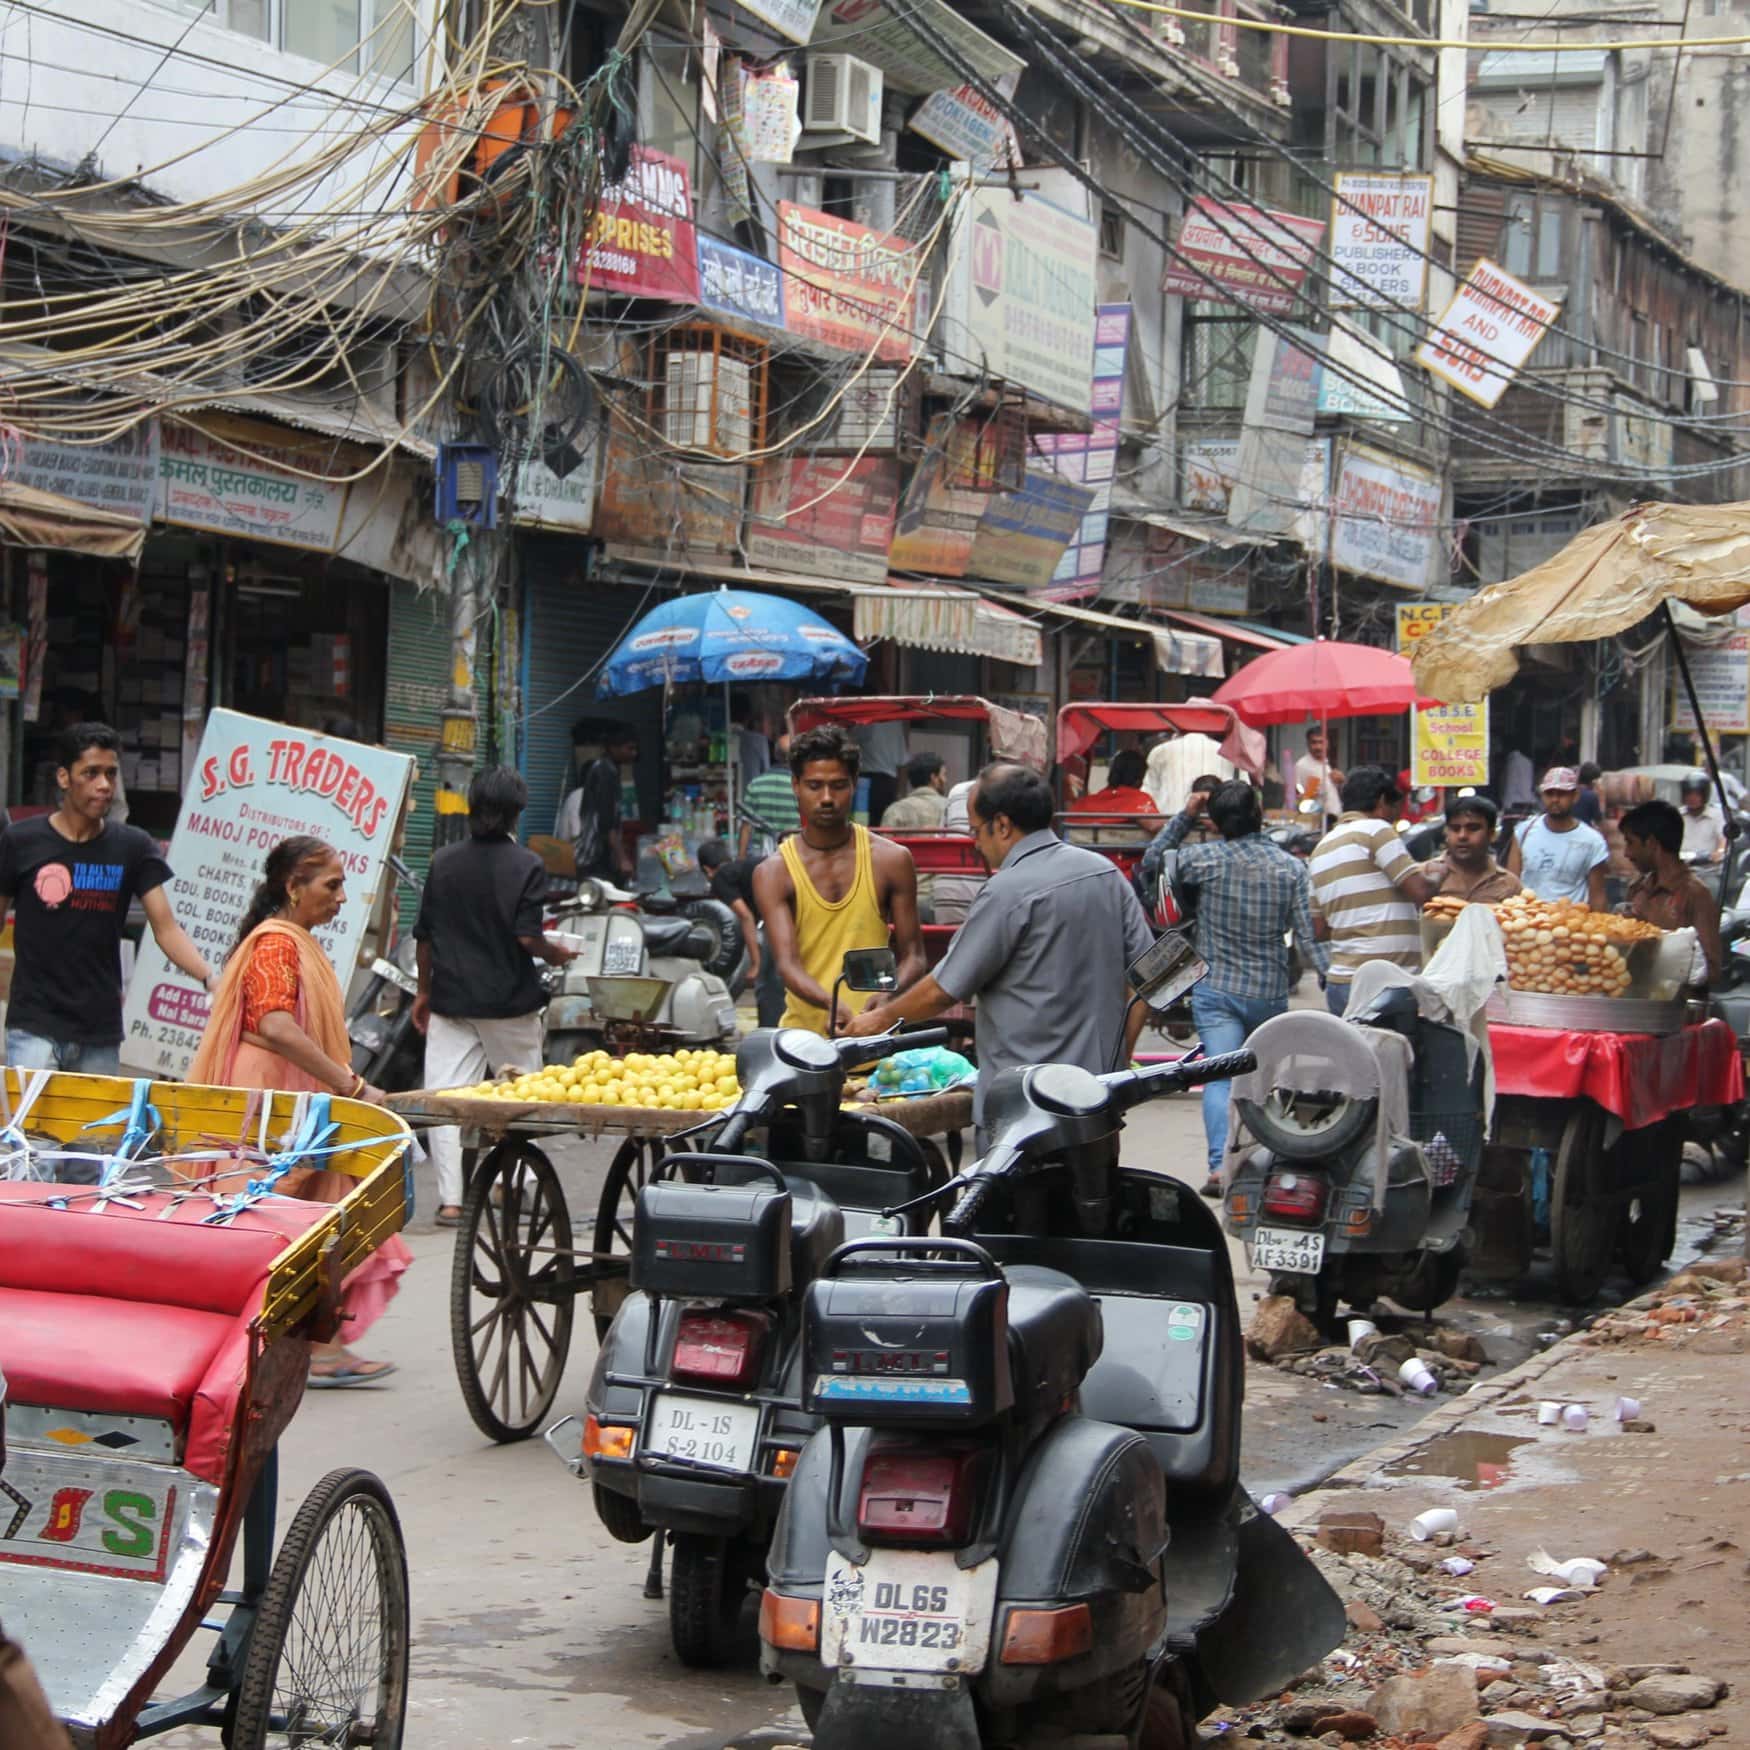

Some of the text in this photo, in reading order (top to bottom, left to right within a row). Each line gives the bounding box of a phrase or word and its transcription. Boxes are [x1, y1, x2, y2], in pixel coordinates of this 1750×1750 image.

[1403, 194, 1426, 219] RAI
[1363, 220, 1411, 244] SONS
[1334, 246, 1422, 262] PUBLISHERS
[1356, 262, 1402, 276] BOOK
[1340, 277, 1409, 293] SELERS
[1462, 313, 1499, 342] AND
[1430, 722, 1473, 733] School
[1421, 749, 1481, 761] COLLEGE
[1428, 765, 1476, 777] BOOKS
[202, 740, 388, 838] S.G. TRADERS
[187, 812, 245, 844] MANOJ
[173, 879, 200, 898] EDU.
[176, 900, 240, 929] COL. BOOK
[156, 985, 180, 1004] Add
[157, 1004, 178, 1021] Nai
[131, 1019, 153, 1040] Ph.
[875, 1582, 949, 1613] DL6S
[859, 1617, 960, 1650] W2823
